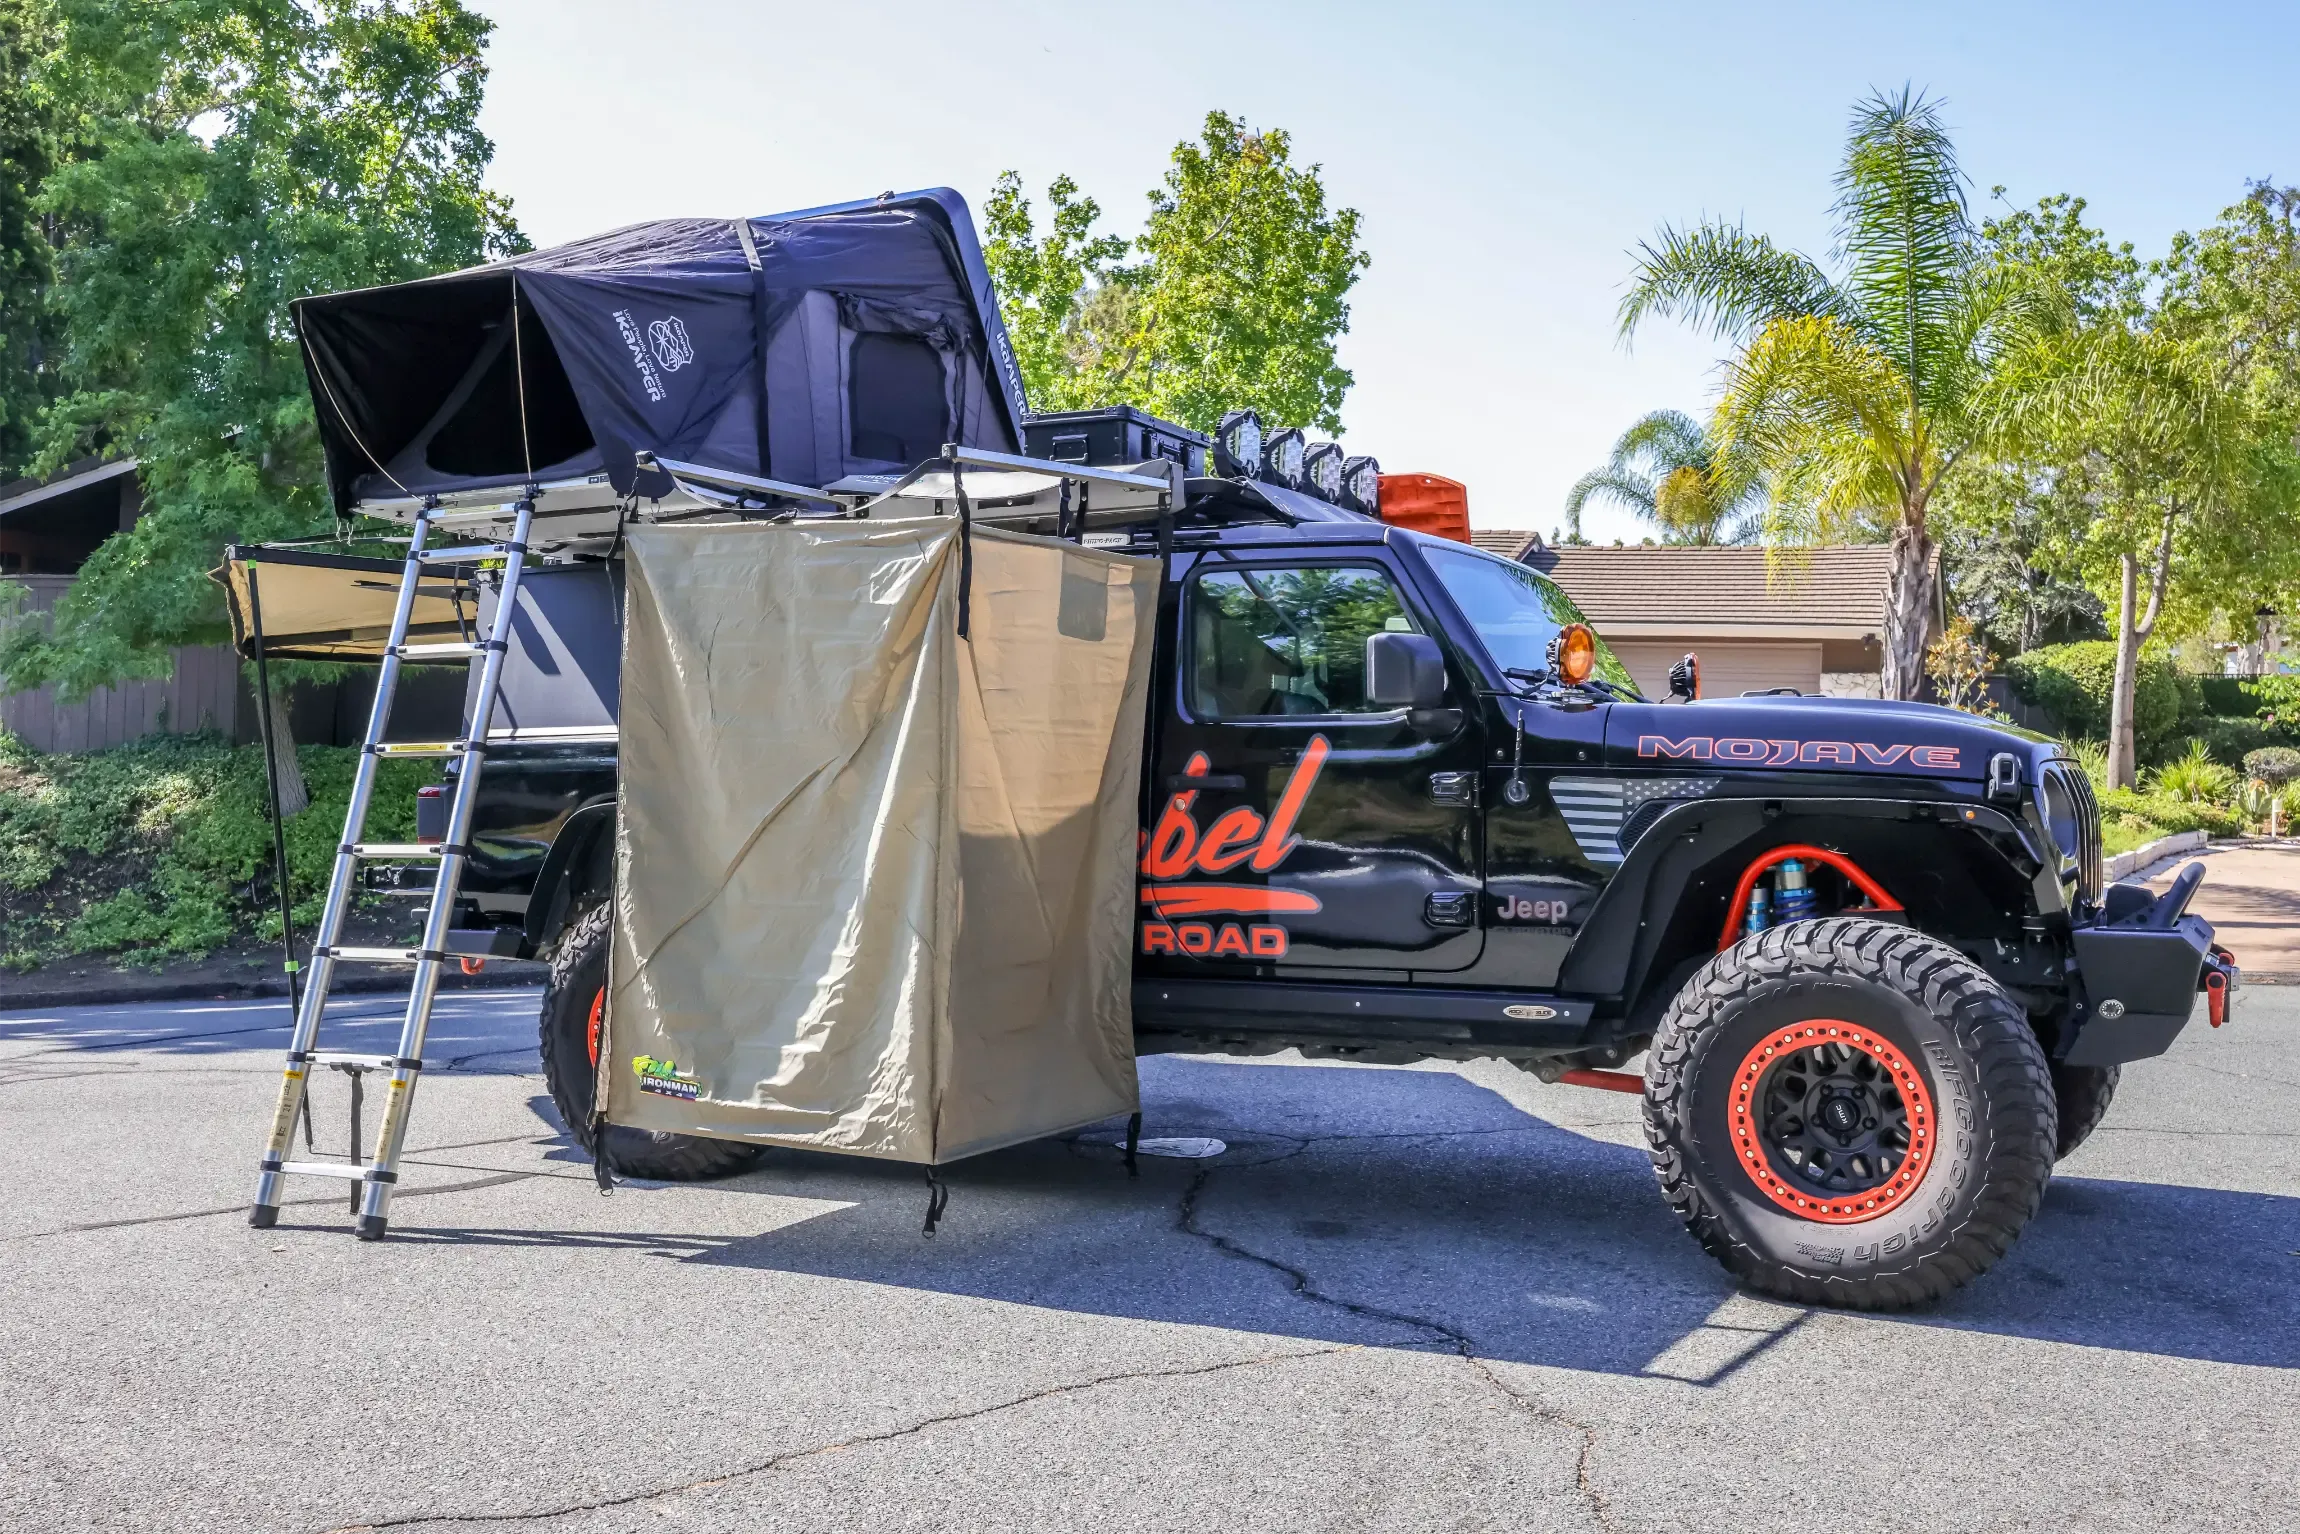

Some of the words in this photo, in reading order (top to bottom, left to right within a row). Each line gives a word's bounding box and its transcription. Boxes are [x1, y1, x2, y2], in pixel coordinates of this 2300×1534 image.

[1638, 735, 1960, 768] MOJAVE
[1137, 735, 1330, 880] bel
[1497, 894, 1568, 924] Jeep
[1143, 923, 1287, 956] ROAD
[643, 1077, 698, 1094] IRONMAN
